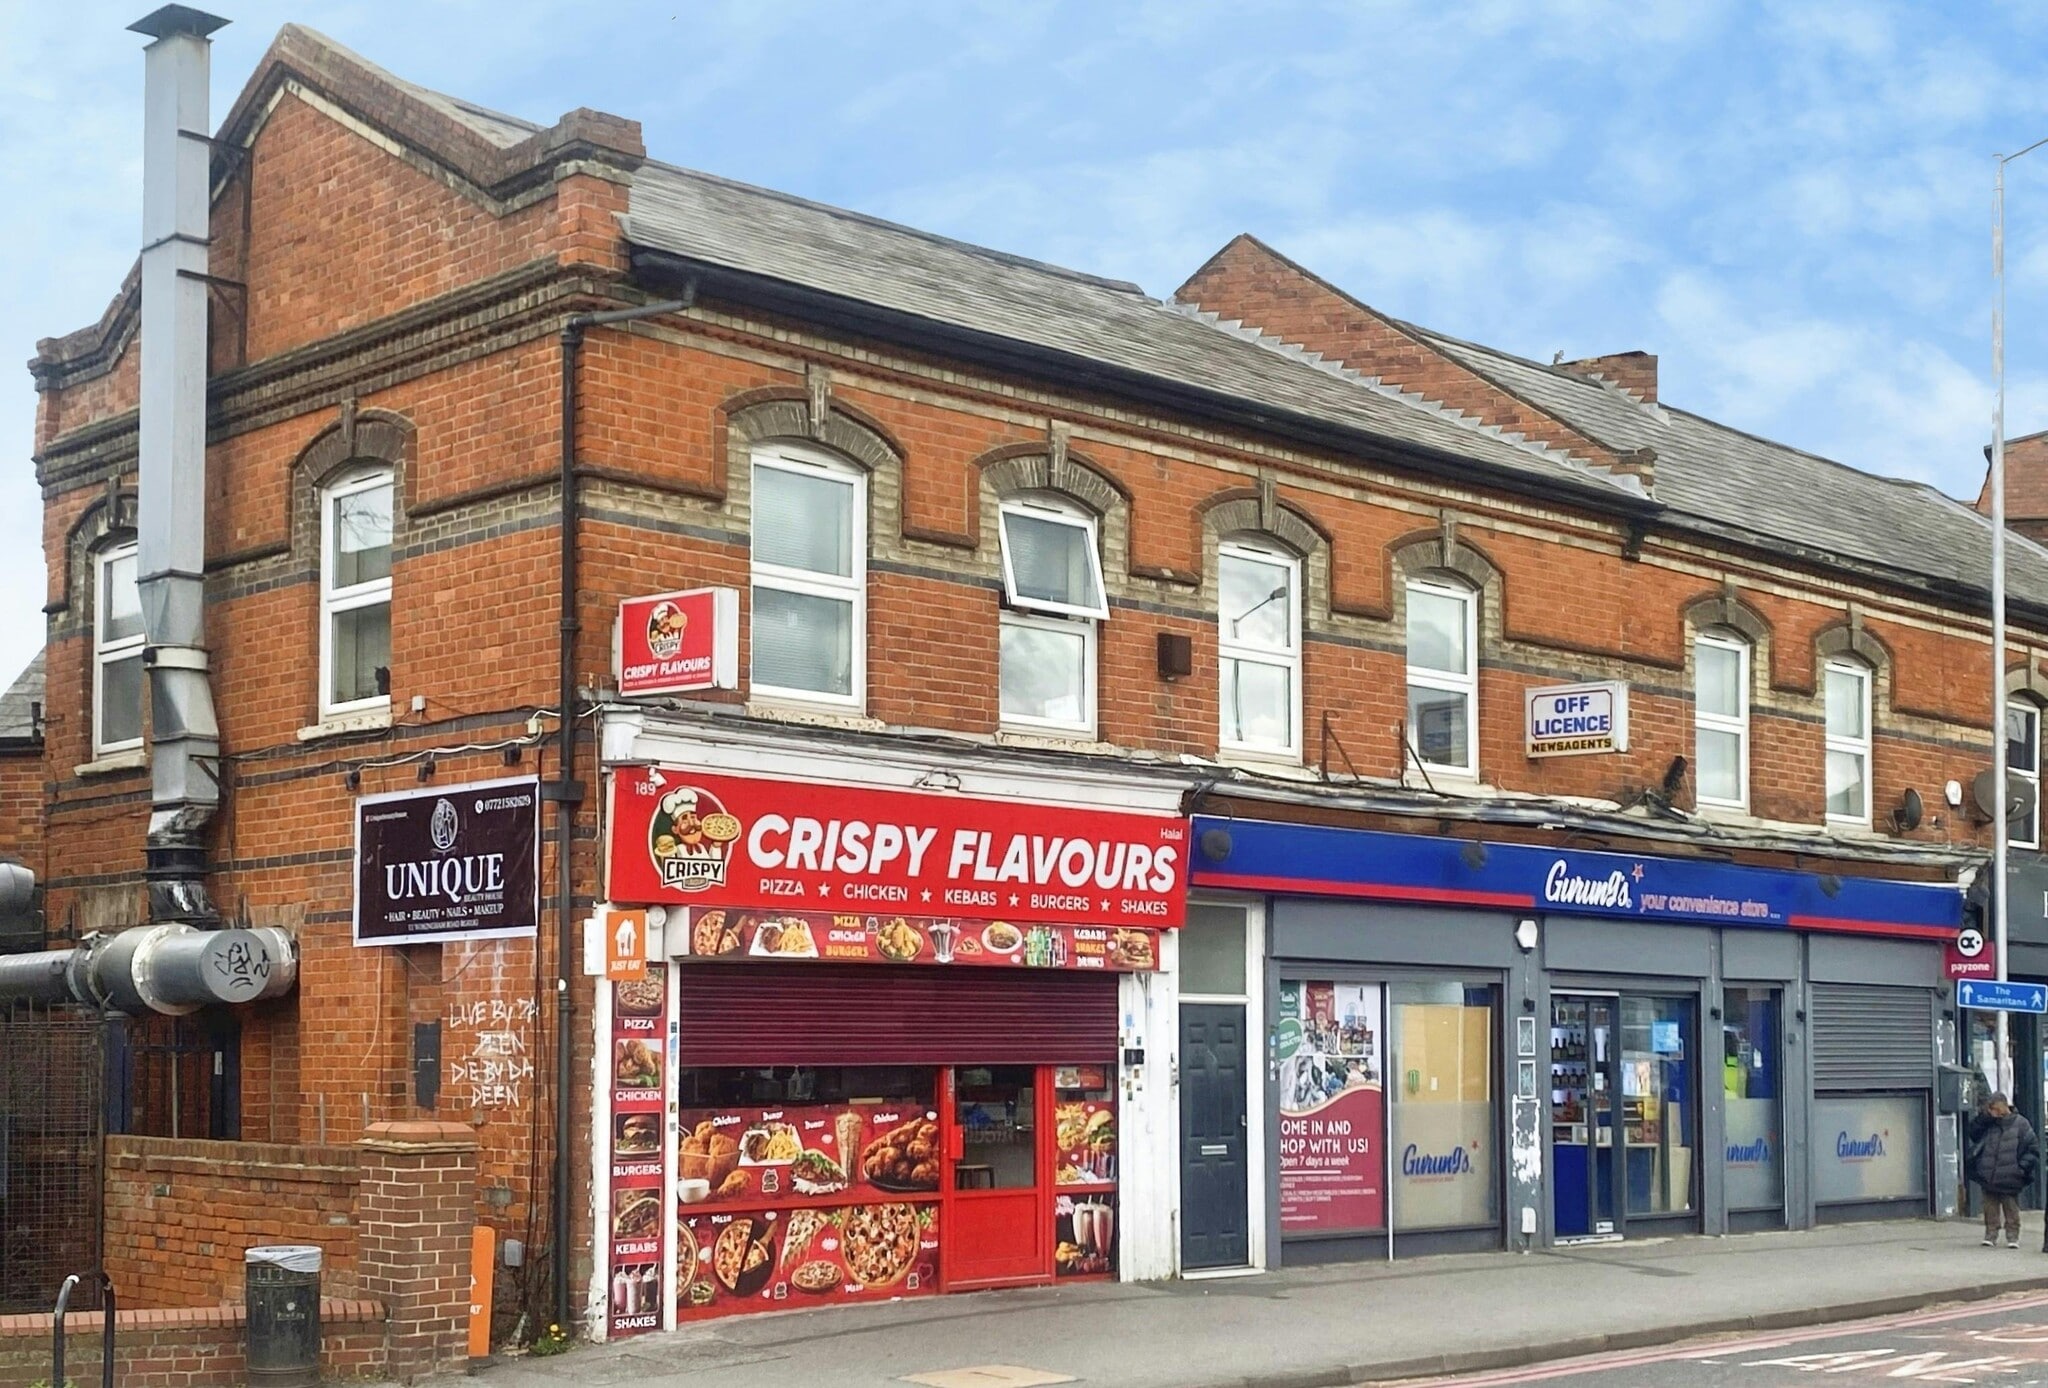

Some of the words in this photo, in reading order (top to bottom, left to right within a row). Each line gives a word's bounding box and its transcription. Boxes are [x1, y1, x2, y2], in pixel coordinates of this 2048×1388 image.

[624, 663, 658, 680] CRISPY
[660, 656, 711, 675] FLAVOURS
[1554, 696, 1590, 714] OFF
[1535, 715, 1609, 735] LICENCE
[1531, 738, 1612, 753] NEWSAGENTS
[635, 781, 656, 796] 189
[1160, 827, 1183, 840] Halal
[748, 814, 938, 878] CRISPY
[947, 829, 1178, 894] FLAVOURS
[385, 853, 504, 903] UNIQUE
[666, 861, 721, 880] CRISPY
[759, 878, 805, 897] PIZZA
[843, 883, 908, 901] CHICKEN
[944, 890, 997, 906] KEBABS
[1031, 894, 1090, 911] BURGERS
[1121, 899, 1168, 916] SHAKES
[389, 911, 406, 922] HAIR
[412, 908, 440, 920] BEAUTY
[446, 906, 468, 918] NAILS
[474, 903, 504, 916] MAKEUP
[1640, 893, 1668, 914] your
[1668, 894, 1739, 916] convenience
[1740, 898, 1768, 918] store
[833, 915, 861, 928] PIZZA
[1073, 928, 1107, 941] KEBABS
[826, 945, 869, 957] BURGERS
[1075, 942, 1106, 954] SHAKES
[610, 960, 627, 972] JUST
[627, 959, 642, 971] EAT
[1951, 963, 1990, 974] payzone
[1994, 986, 2011, 995] The
[1977, 994, 2027, 1006] Samaritans
[449, 1001, 487, 1028] LIVE
[624, 1019, 655, 1030] PIZZA
[450, 1060, 479, 1085] DIE
[507, 1057, 535, 1081] DA
[470, 1081, 521, 1108] DEEN
[615, 1091, 662, 1102] CHICKEN
[712, 1115, 741, 1127] Chicken
[1281, 1119, 1308, 1135] OME
[1311, 1119, 1324, 1135] IN
[1327, 1119, 1352, 1135] AND
[1280, 1138, 1306, 1154] HOP
[1309, 1138, 1341, 1154] WITH
[1348, 1137, 1369, 1154] US!
[1726, 1137, 1769, 1162] urung's
[1305, 1155, 1323, 1169] days
[1331, 1155, 1350, 1167] week
[613, 1164, 663, 1177] BURGERS
[615, 1241, 658, 1255] KEBABS
[615, 1315, 657, 1330] SHAKES
